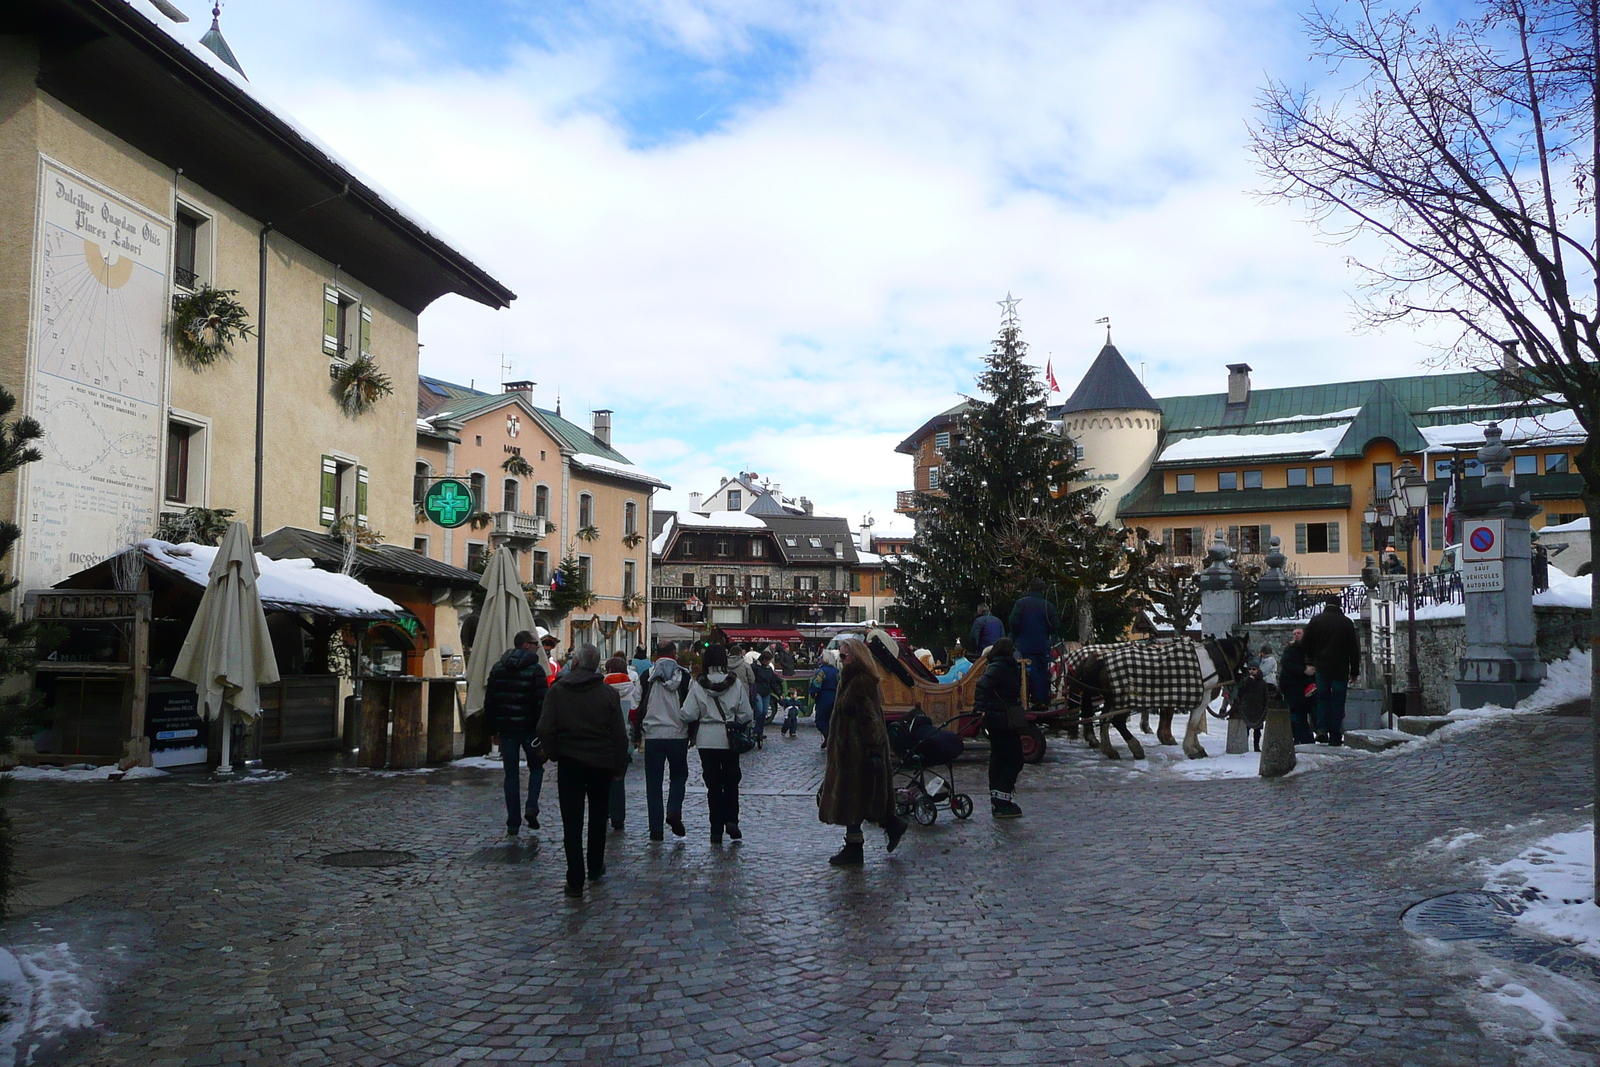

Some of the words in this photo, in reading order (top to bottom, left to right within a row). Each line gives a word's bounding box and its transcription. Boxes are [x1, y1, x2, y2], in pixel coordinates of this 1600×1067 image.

[55, 178, 95, 213] Dulcibus
[75, 209, 107, 239] Plures
[111, 227, 142, 256] Labori
